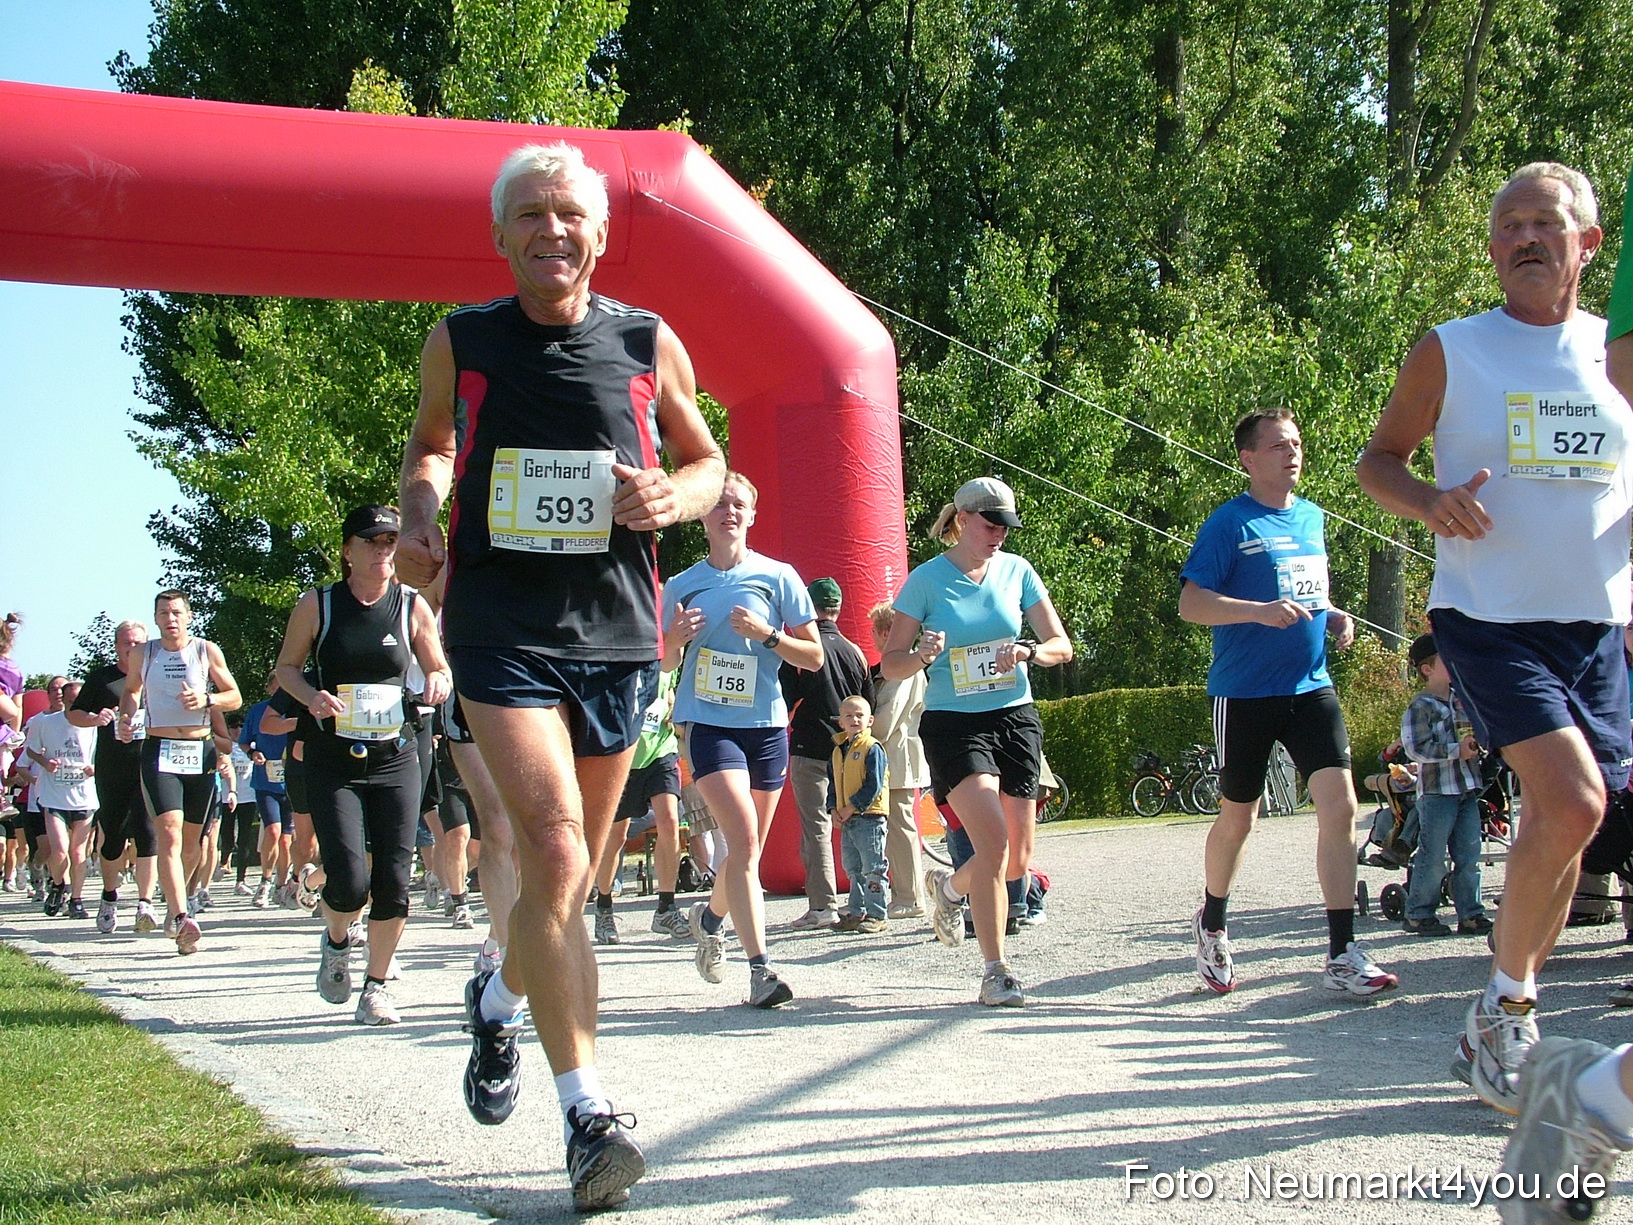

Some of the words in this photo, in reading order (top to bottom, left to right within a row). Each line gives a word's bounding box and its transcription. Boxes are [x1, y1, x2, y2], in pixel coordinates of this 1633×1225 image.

[1539, 399, 1598, 417] Herbert
[1553, 431, 1606, 455] 527
[524, 458, 591, 480] Gerhard
[495, 487, 503, 502] C
[535, 495, 595, 525] 593
[1295, 580, 1322, 596] 224
[966, 645, 991, 657] Petra
[711, 655, 745, 670] Gabriele
[716, 675, 746, 692] 158
[363, 709, 393, 725] 111
[645, 712, 659, 723] 54
